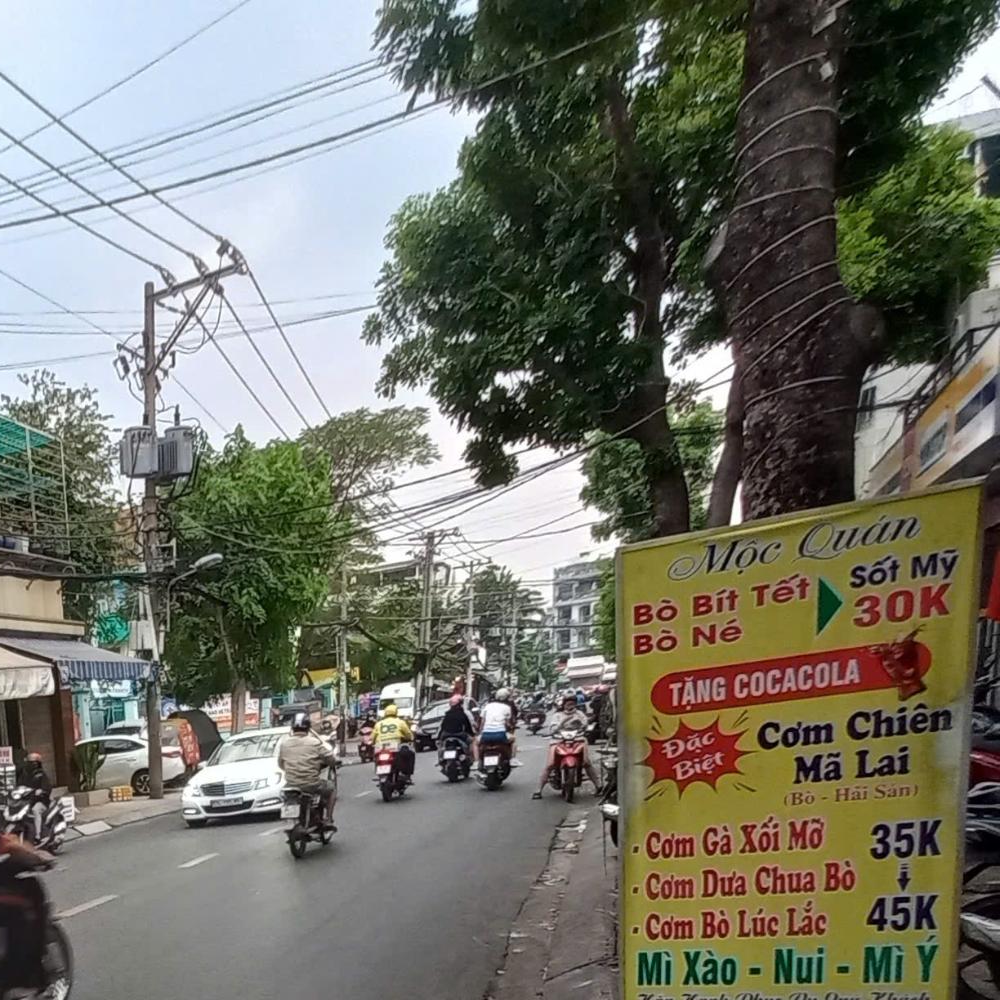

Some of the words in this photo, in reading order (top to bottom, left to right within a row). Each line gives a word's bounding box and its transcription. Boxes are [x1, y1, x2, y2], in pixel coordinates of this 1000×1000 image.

[667, 538, 782, 581] Mộc
[793, 514, 921, 562] Quán
[850, 554, 899, 588] Sốt
[911, 549, 959, 580] Mỹ
[633, 600, 678, 626] Bò
[692, 588, 739, 617] Bít
[752, 573, 811, 607] Tết
[853, 582, 952, 628] 30K
[633, 630, 678, 656] Bò
[691, 619, 743, 648] Né
[669, 672, 726, 711] TẶNG
[734, 658, 861, 698] COCACOLA
[380, 723, 397, 734] be
[661, 728, 716, 759] Đặc
[757, 719, 833, 750] Cơm
[847, 704, 953, 738] Chiên
[672, 751, 724, 782] Biệt
[793, 753, 842, 784] Mã
[856, 746, 910, 778] Lai
[645, 831, 695, 859] Cơm
[702, 827, 732, 855] Gà
[739, 816, 780, 853] Xối
[788, 818, 824, 850] Mỡ
[869, 819, 943, 860] 35K
[645, 871, 695, 900] Cơm
[702, 868, 747, 897] Dưa
[755, 866, 816, 895] Chua
[825, 860, 856, 892] Bò
[645, 913, 694, 940] Cơm
[701, 910, 730, 939] Bò
[738, 907, 779, 938] Lúc
[786, 900, 828, 937] Lắc
[866, 895, 939, 932] 45K
[637, 951, 672, 986] Mì
[682, 950, 737, 986] Xào
[748, 967, 761, 975] -
[773, 947, 824, 984] Nui
[863, 945, 904, 984] Mì
[916, 935, 939, 984] Ý
